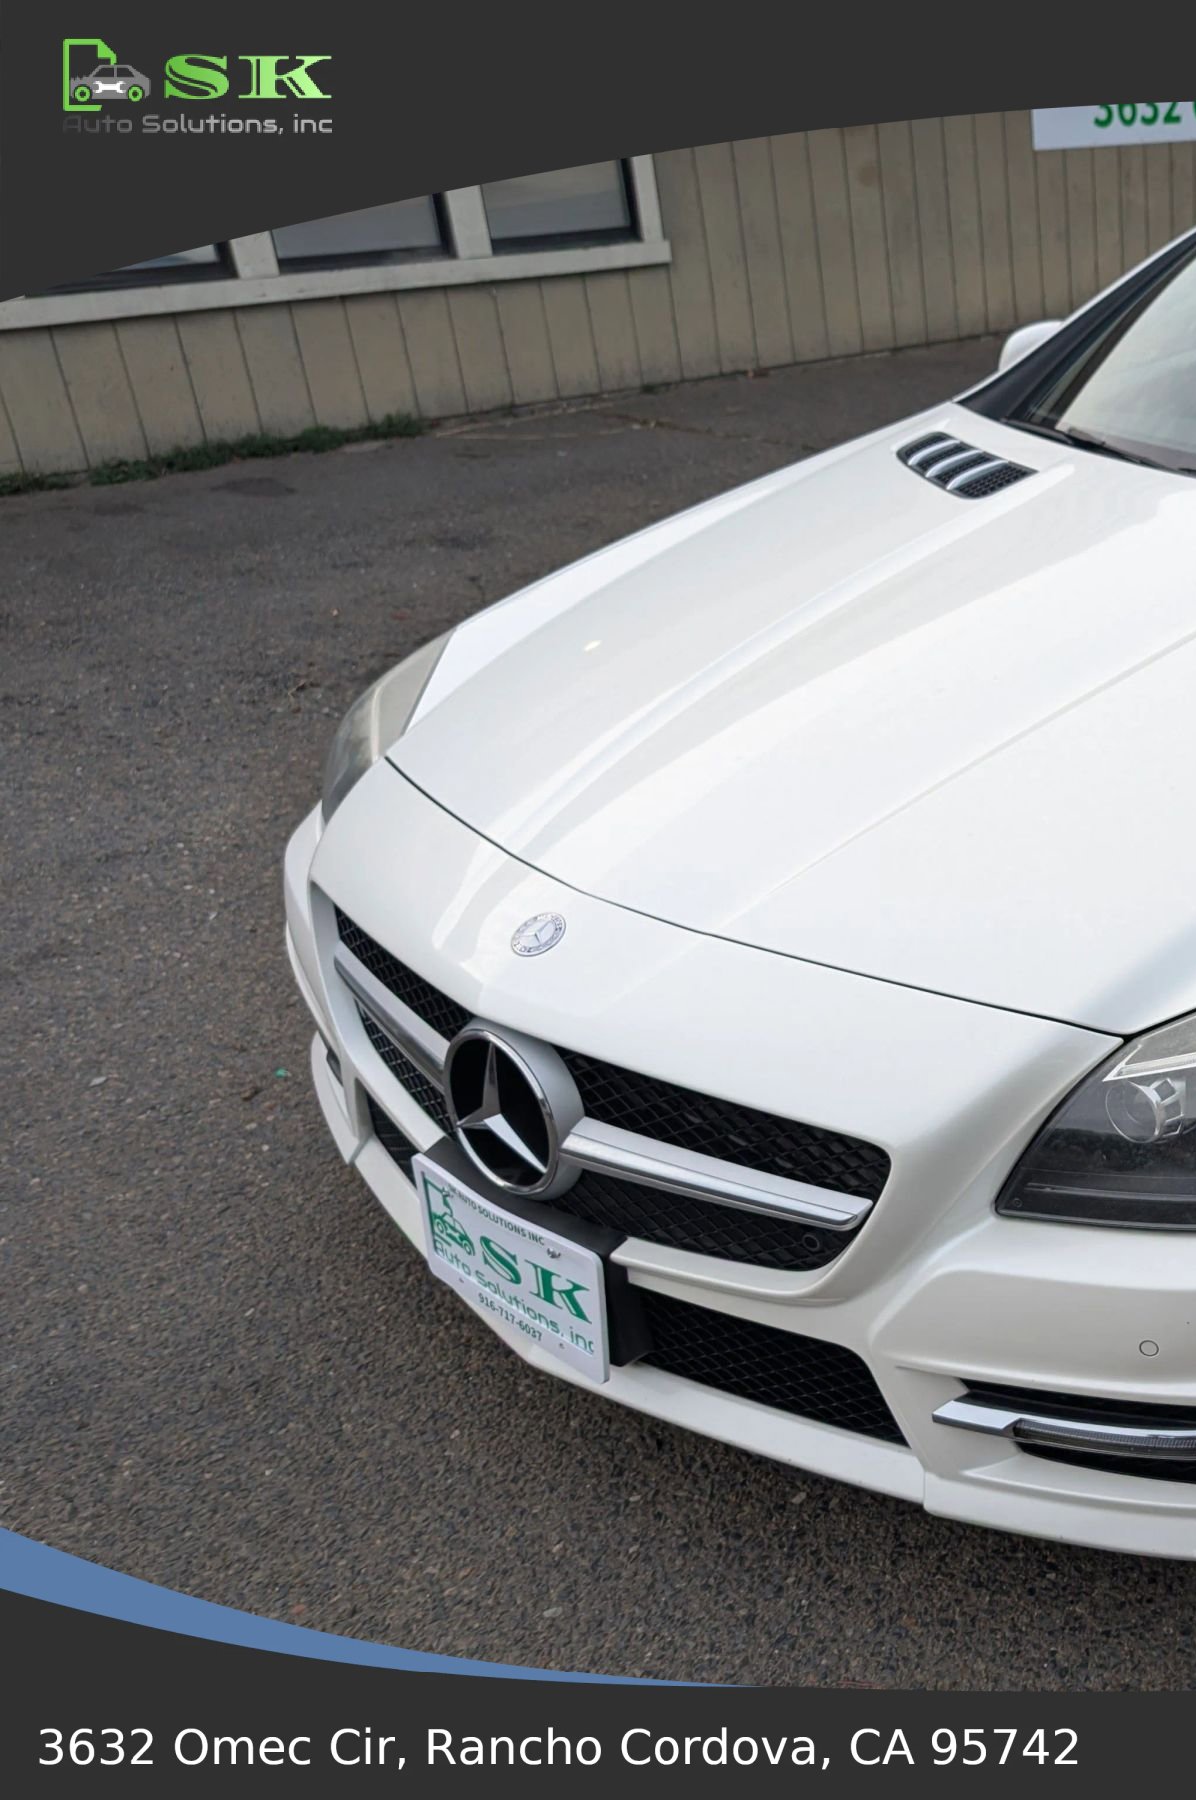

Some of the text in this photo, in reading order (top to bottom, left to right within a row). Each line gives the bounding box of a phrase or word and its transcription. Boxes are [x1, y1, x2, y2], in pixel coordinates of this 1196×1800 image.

[477, 1205, 527, 1238] SOLUTIONS
[528, 1232, 546, 1247] INC
[433, 1238, 472, 1278] Auto
[474, 1269, 565, 1338] Solutions,
[480, 1235, 592, 1325] SK
[478, 1292, 543, 1342] 916-717-6037
